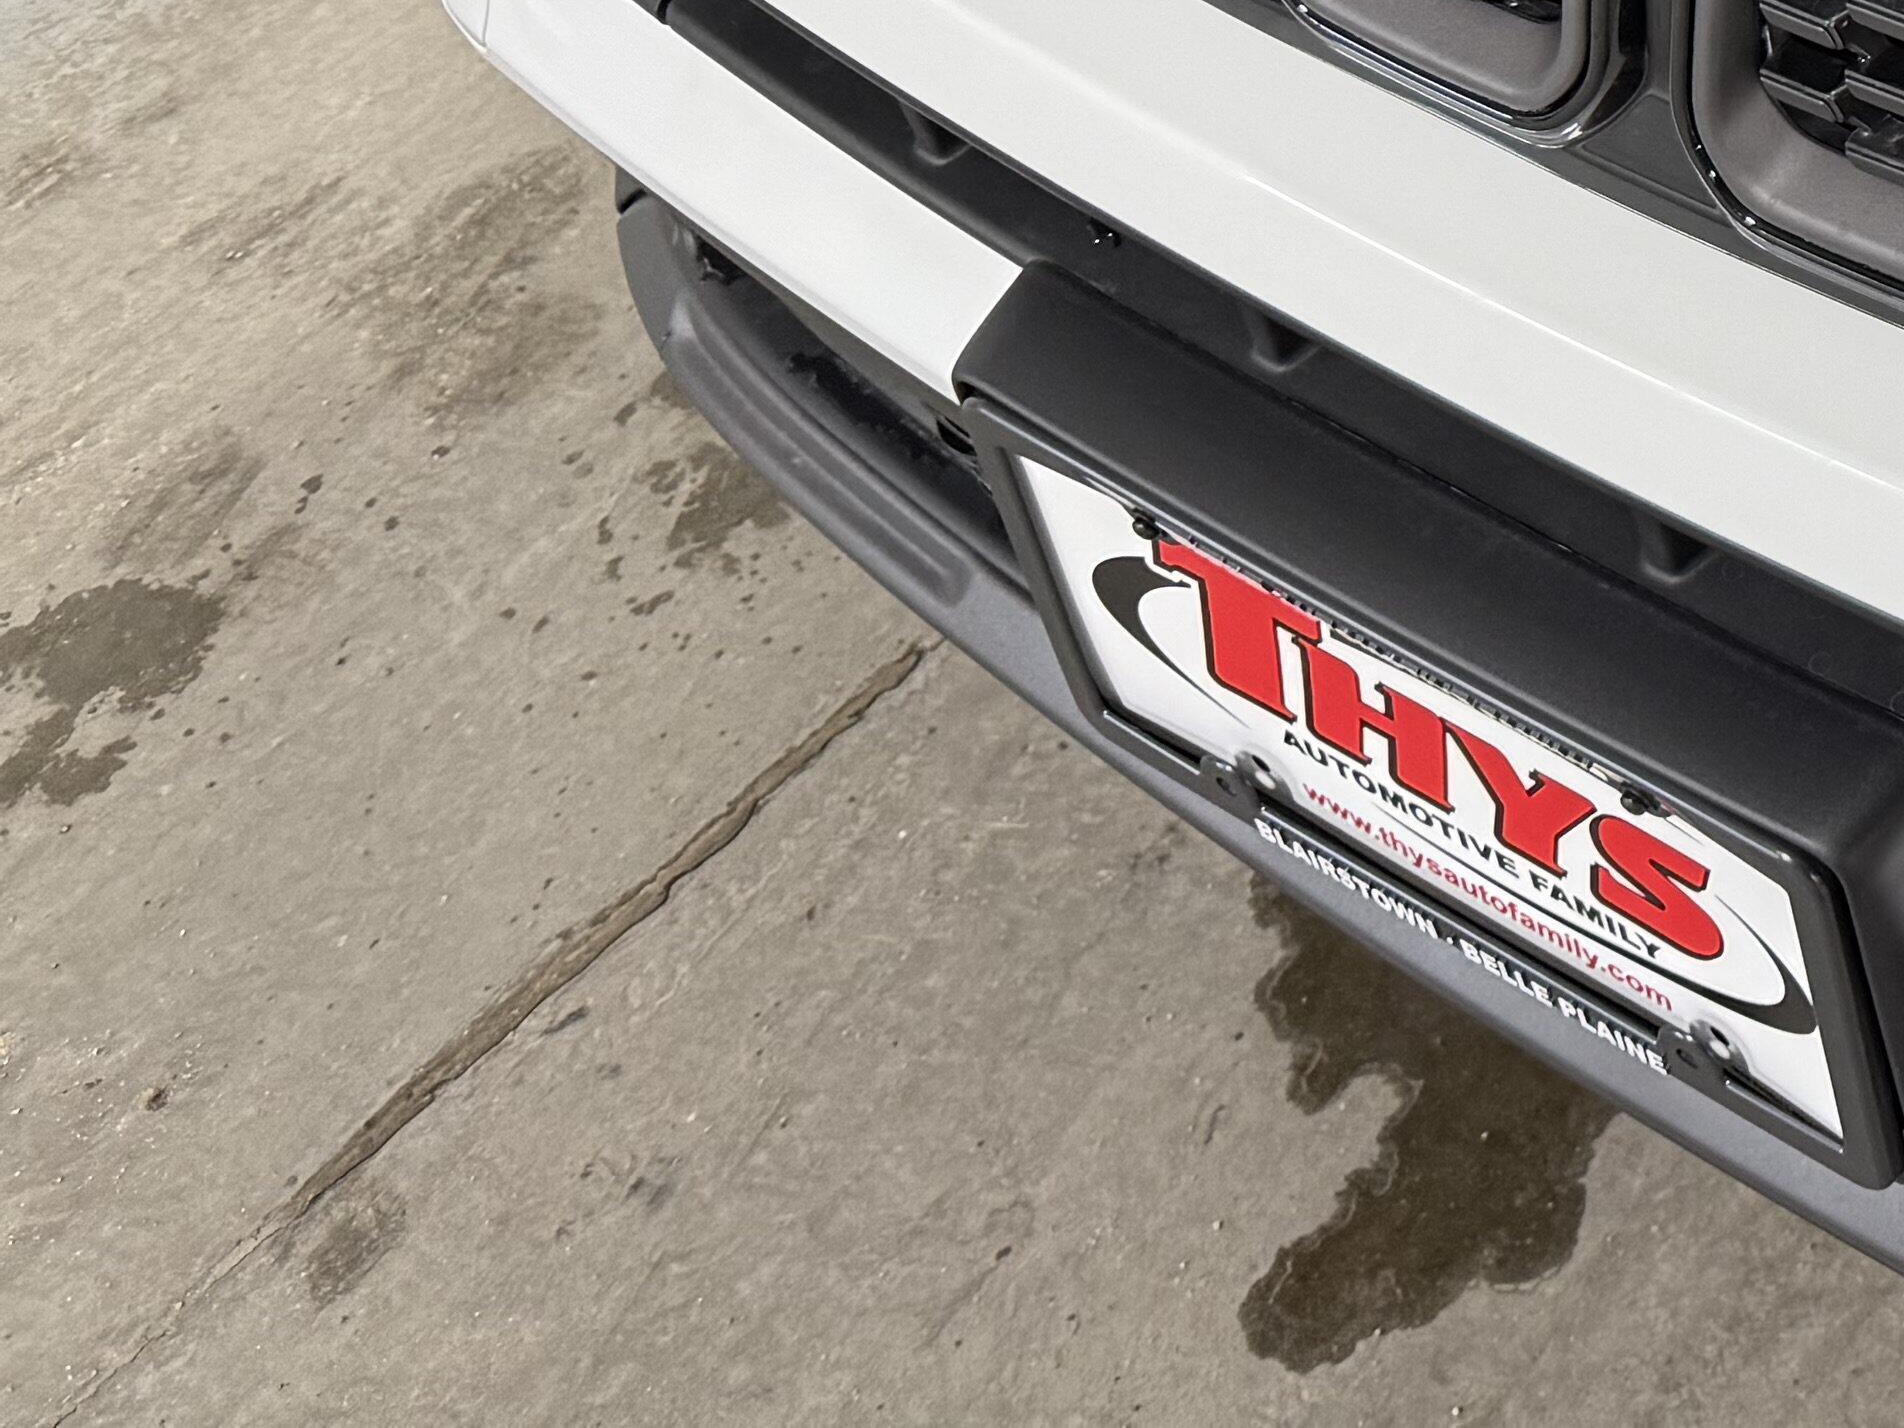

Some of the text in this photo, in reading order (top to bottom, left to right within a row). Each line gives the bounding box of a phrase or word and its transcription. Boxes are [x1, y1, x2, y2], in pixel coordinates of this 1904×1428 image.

[1152, 535, 1727, 962] THYS
[1283, 730, 1521, 880] AUTOMOTIVE
[1529, 867, 1662, 959] FAMILY
[1253, 817, 1670, 1077] BLAIRSTOWN BELLE PLAINE
[1302, 782, 1674, 1013] www.thysautofamily.com
